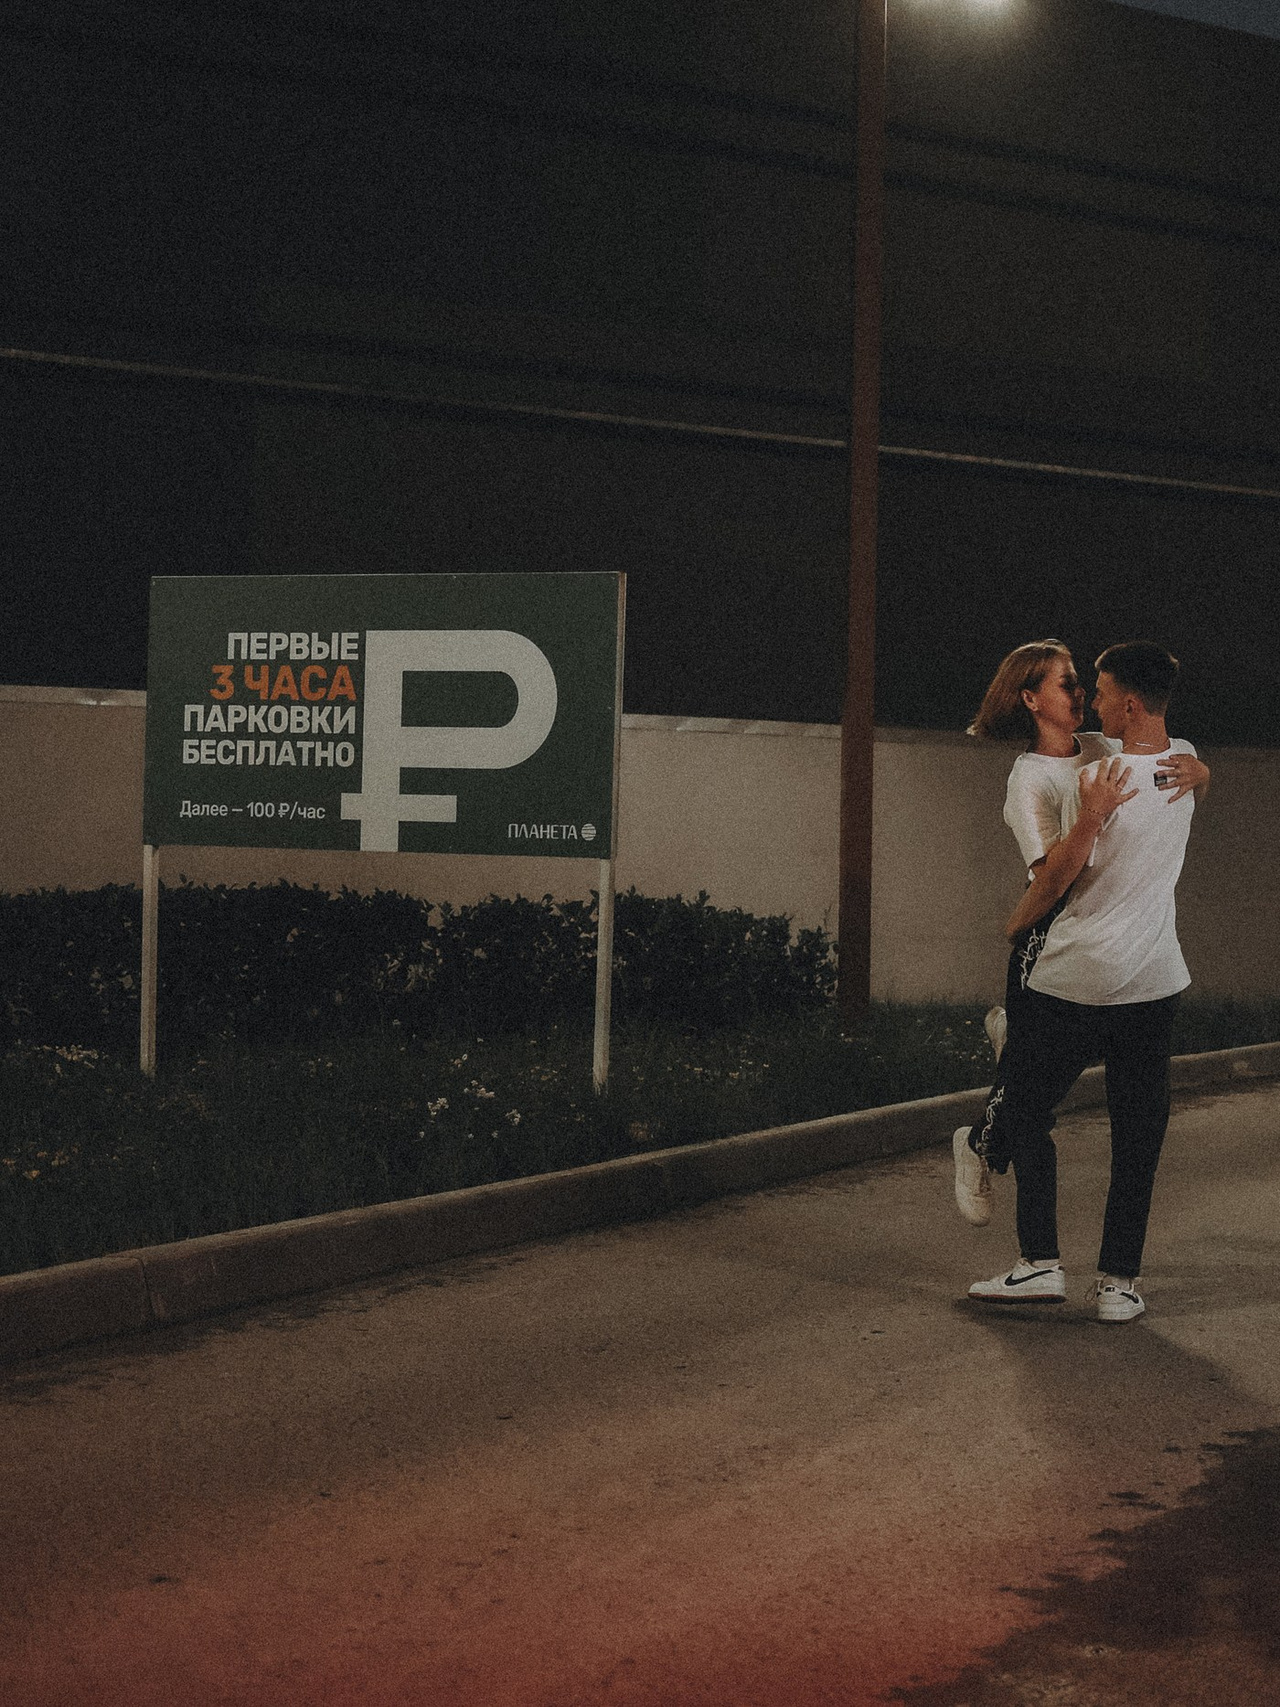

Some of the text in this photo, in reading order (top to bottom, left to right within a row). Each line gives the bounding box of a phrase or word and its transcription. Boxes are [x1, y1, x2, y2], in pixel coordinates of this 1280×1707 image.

[227, 632, 359, 660] ПЕРВЫЕ
[209, 665, 357, 700] 3 ЧАСА
[183, 704, 356, 734] ПАРКОВКИ
[182, 739, 355, 767] БЕСПЛАТНО
[180, 800, 228, 818] Далее
[247, 802, 275, 818] 100
[508, 823, 578, 840] ПЛАНЕТА
